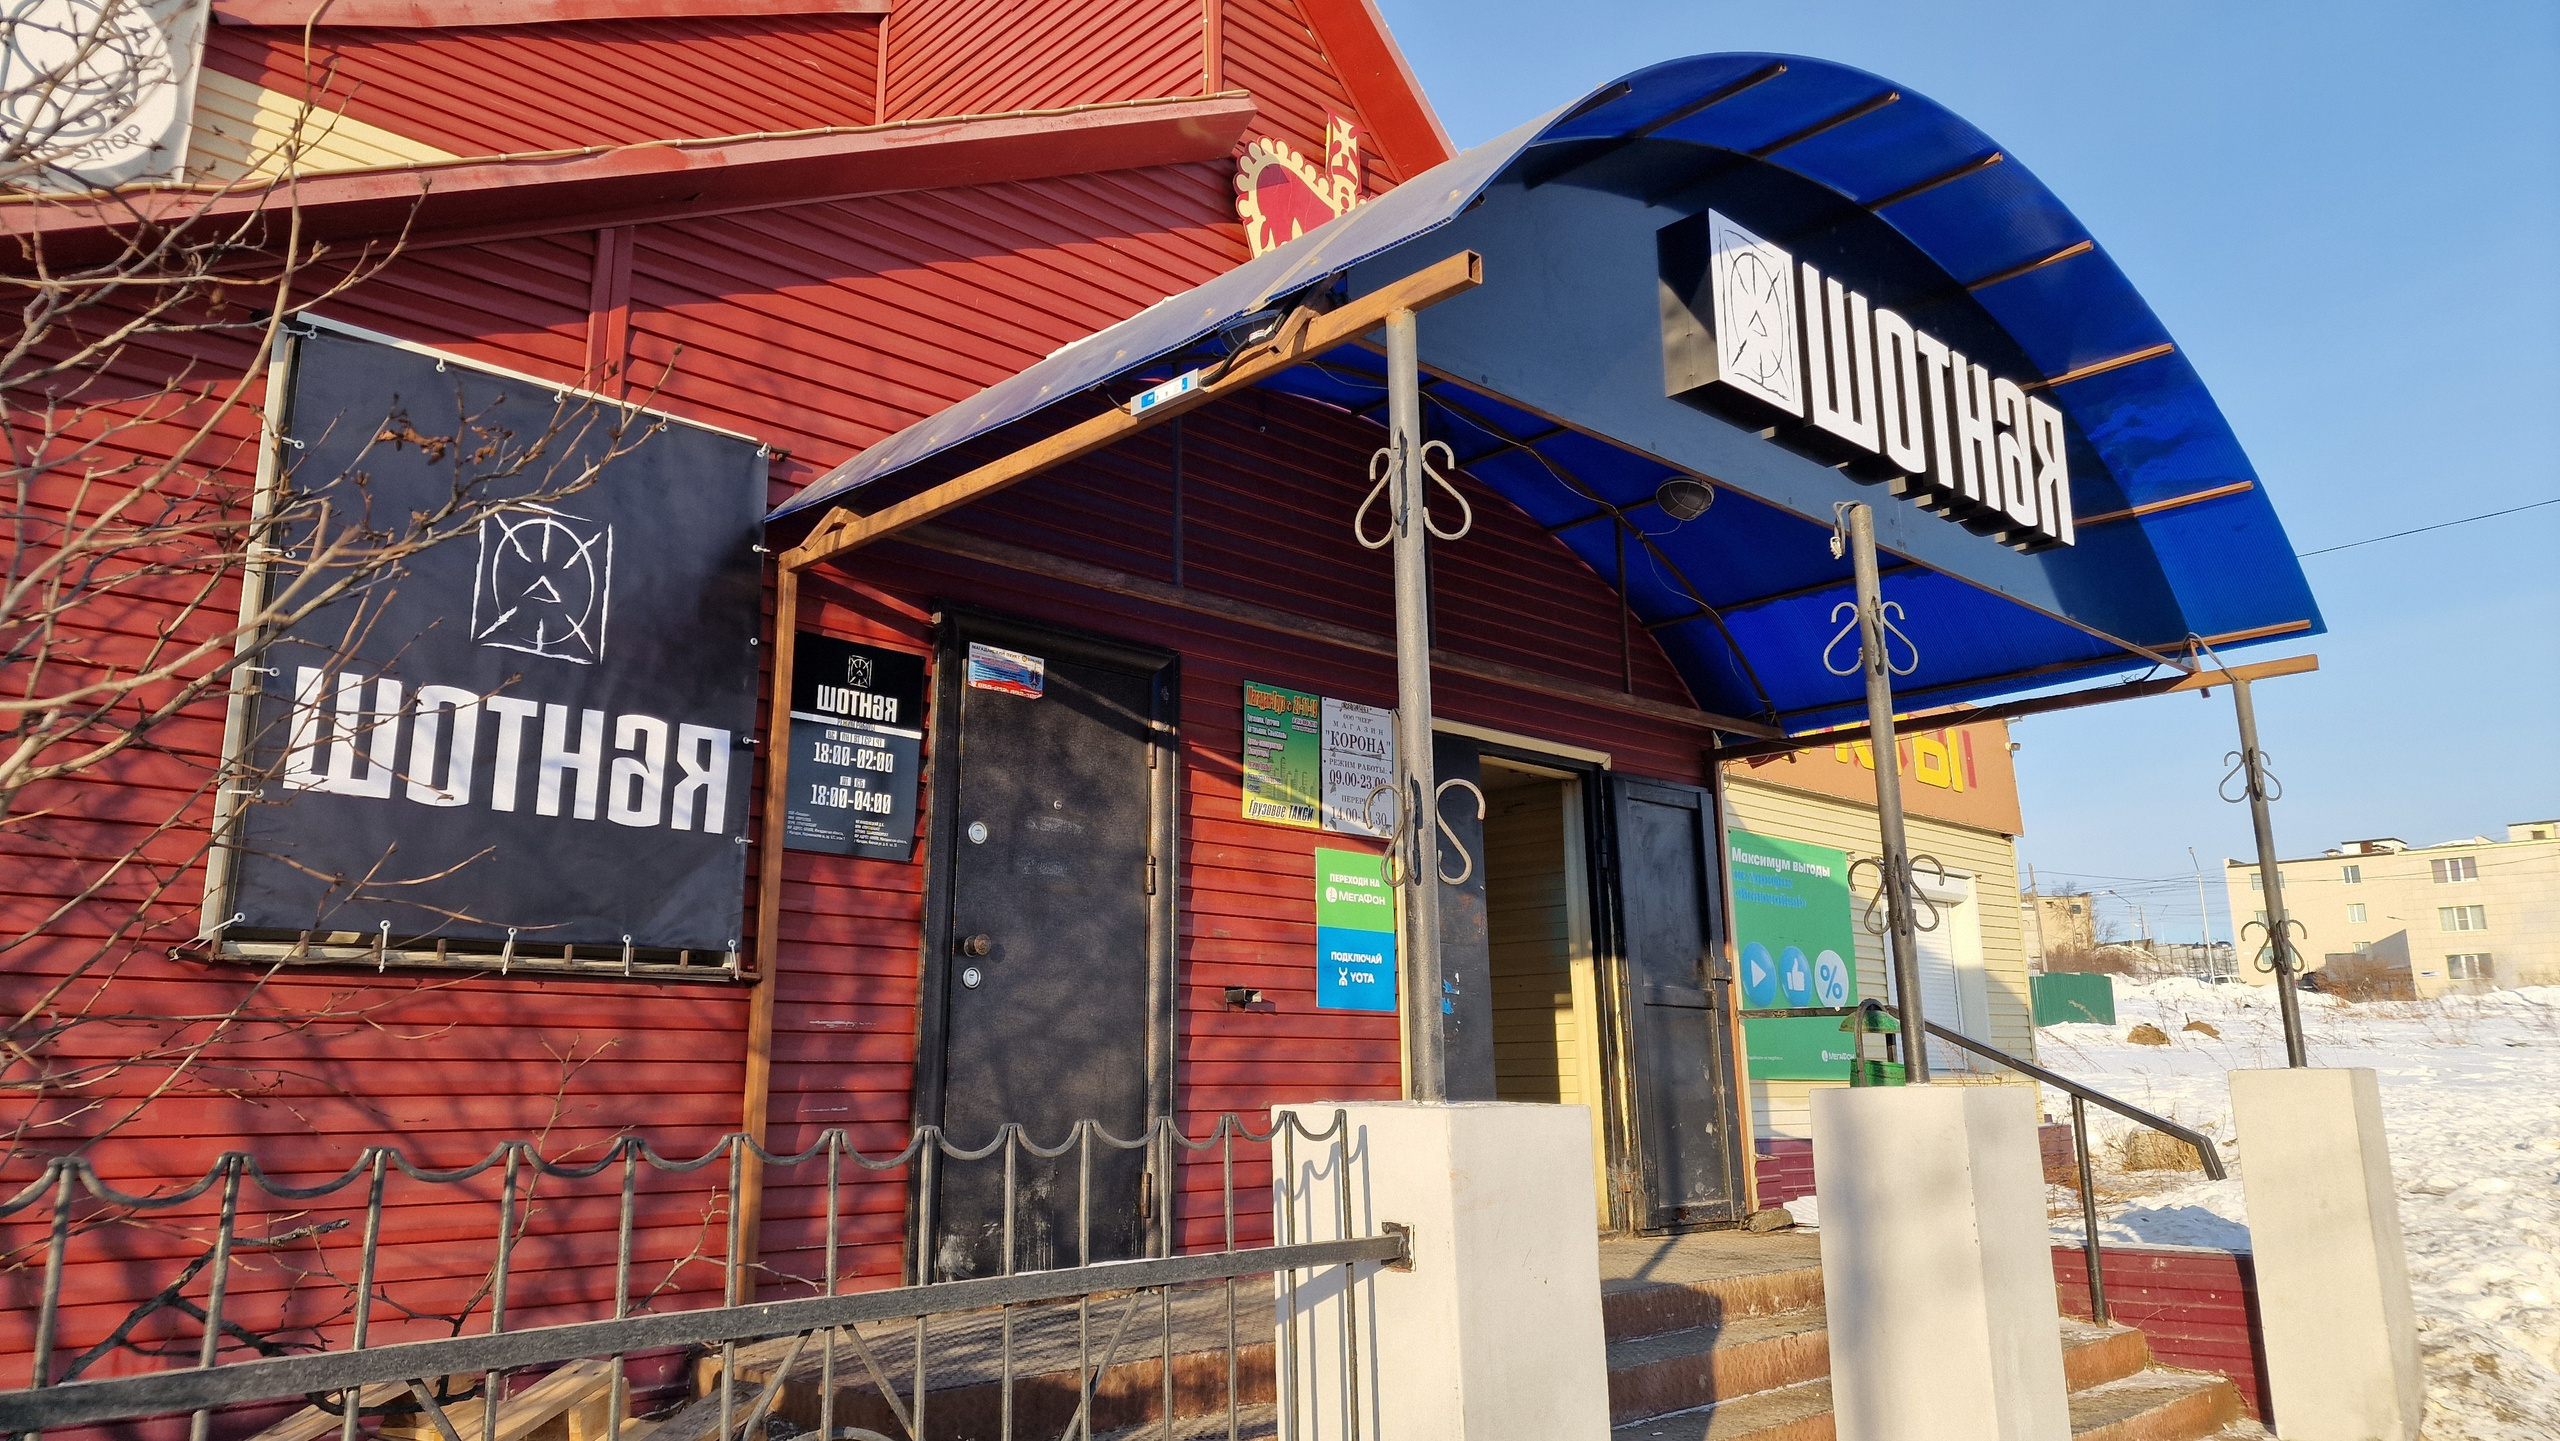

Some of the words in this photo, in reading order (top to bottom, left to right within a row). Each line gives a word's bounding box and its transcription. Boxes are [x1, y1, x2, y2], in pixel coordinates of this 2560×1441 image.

[72, 124, 141, 159] SHOP
[1325, 730, 1391, 755] "КОРОНА"
[813, 742, 894, 773] 18:00-02:00
[1329, 758, 1356, 769] РЕЖИМ
[810, 784, 891, 815] 18:00-04:00
[1248, 799, 1287, 818] Грузовое
[1288, 804, 1314, 822] ТАКСИ
[1731, 847, 1791, 873] Максимум
[1792, 861, 1831, 878] выгоды
[1329, 873, 1368, 887] ПЕРЕХОДИ
[1369, 877, 1381, 888] НА
[1748, 871, 1793, 890] тарифах
[1330, 951, 1383, 964] ПОДКЛЮЧАЙ
[1350, 972, 1375, 984] YOTA
